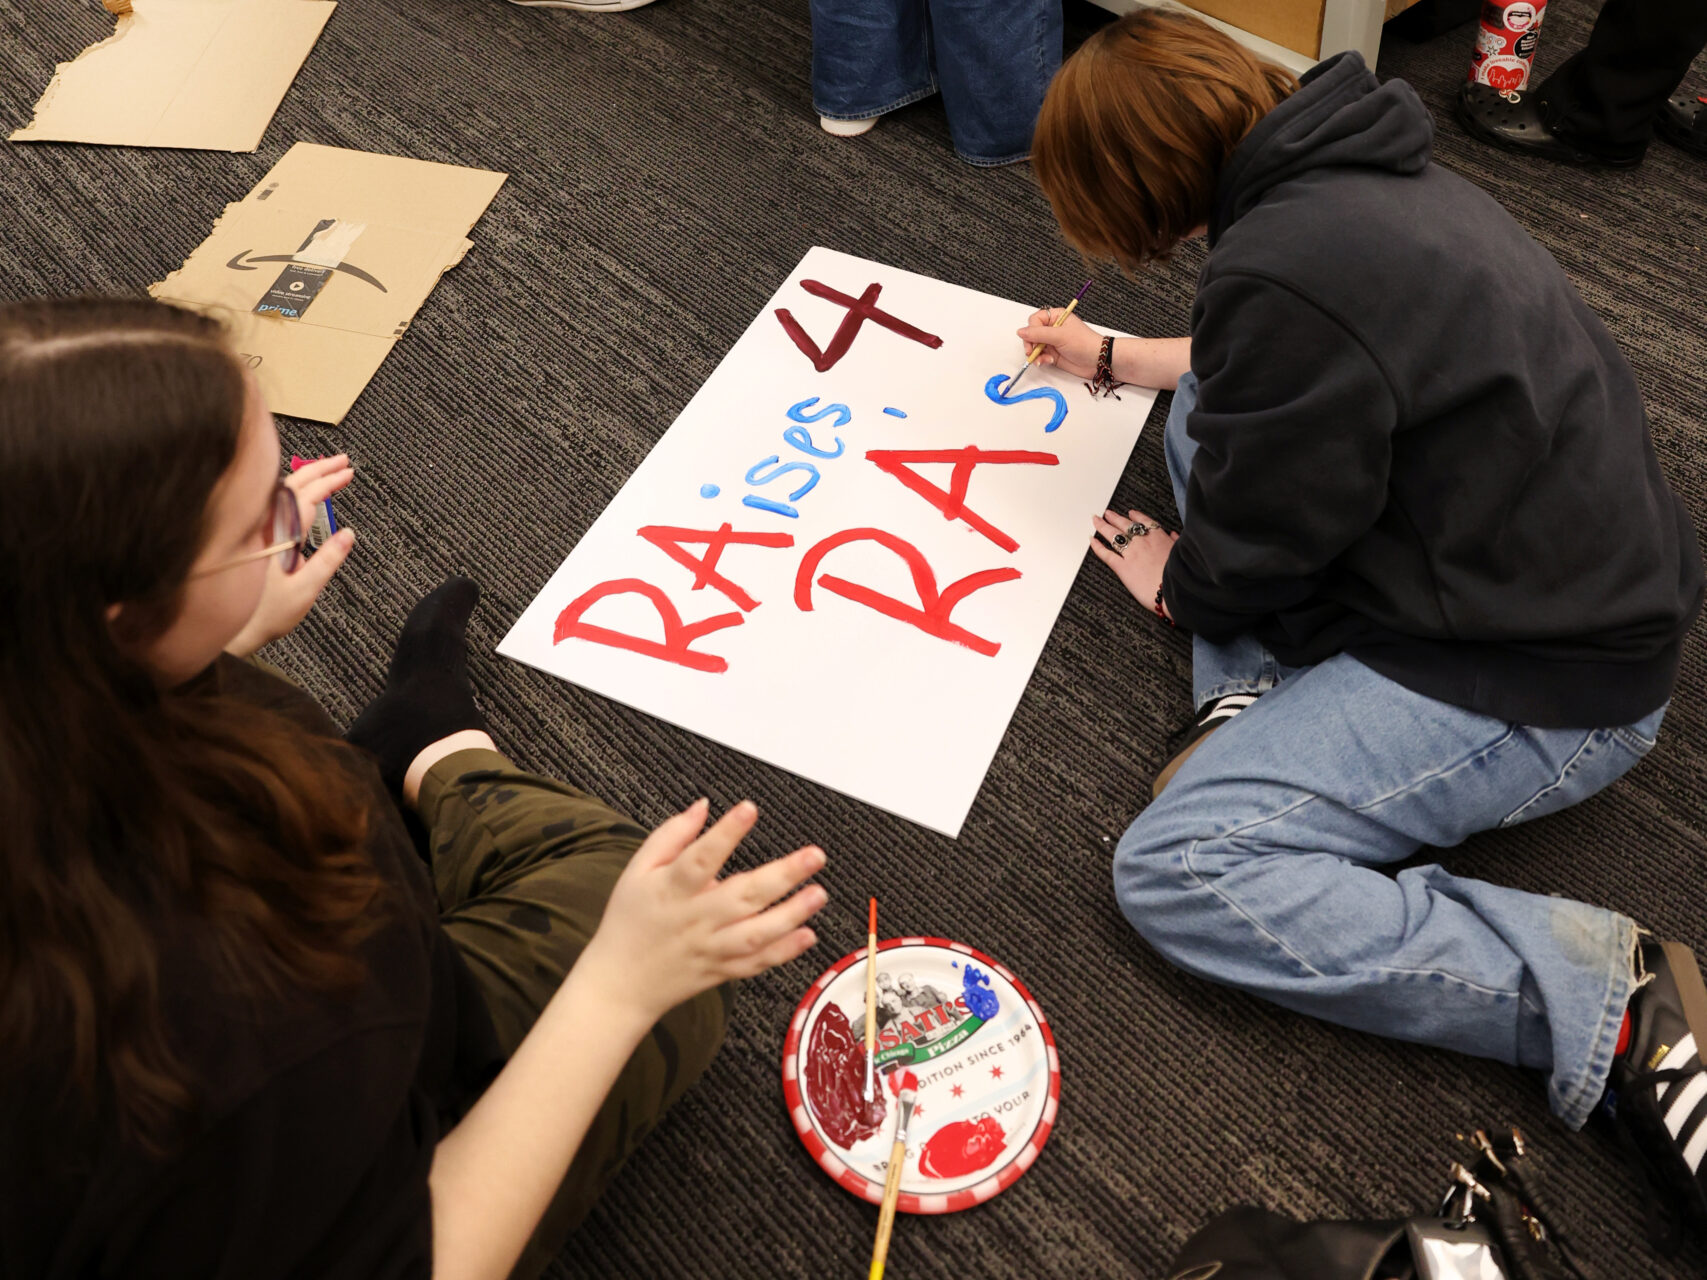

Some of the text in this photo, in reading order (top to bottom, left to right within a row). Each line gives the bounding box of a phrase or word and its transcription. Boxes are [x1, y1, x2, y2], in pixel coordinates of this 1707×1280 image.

[258, 304, 298, 316] prime
[774, 278, 944, 372] 4
[917, 1022, 1033, 1090] DITION SINCE 1964
[926, 1028, 970, 1058] Pizza
[993, 1090, 1031, 1115] YOUR
